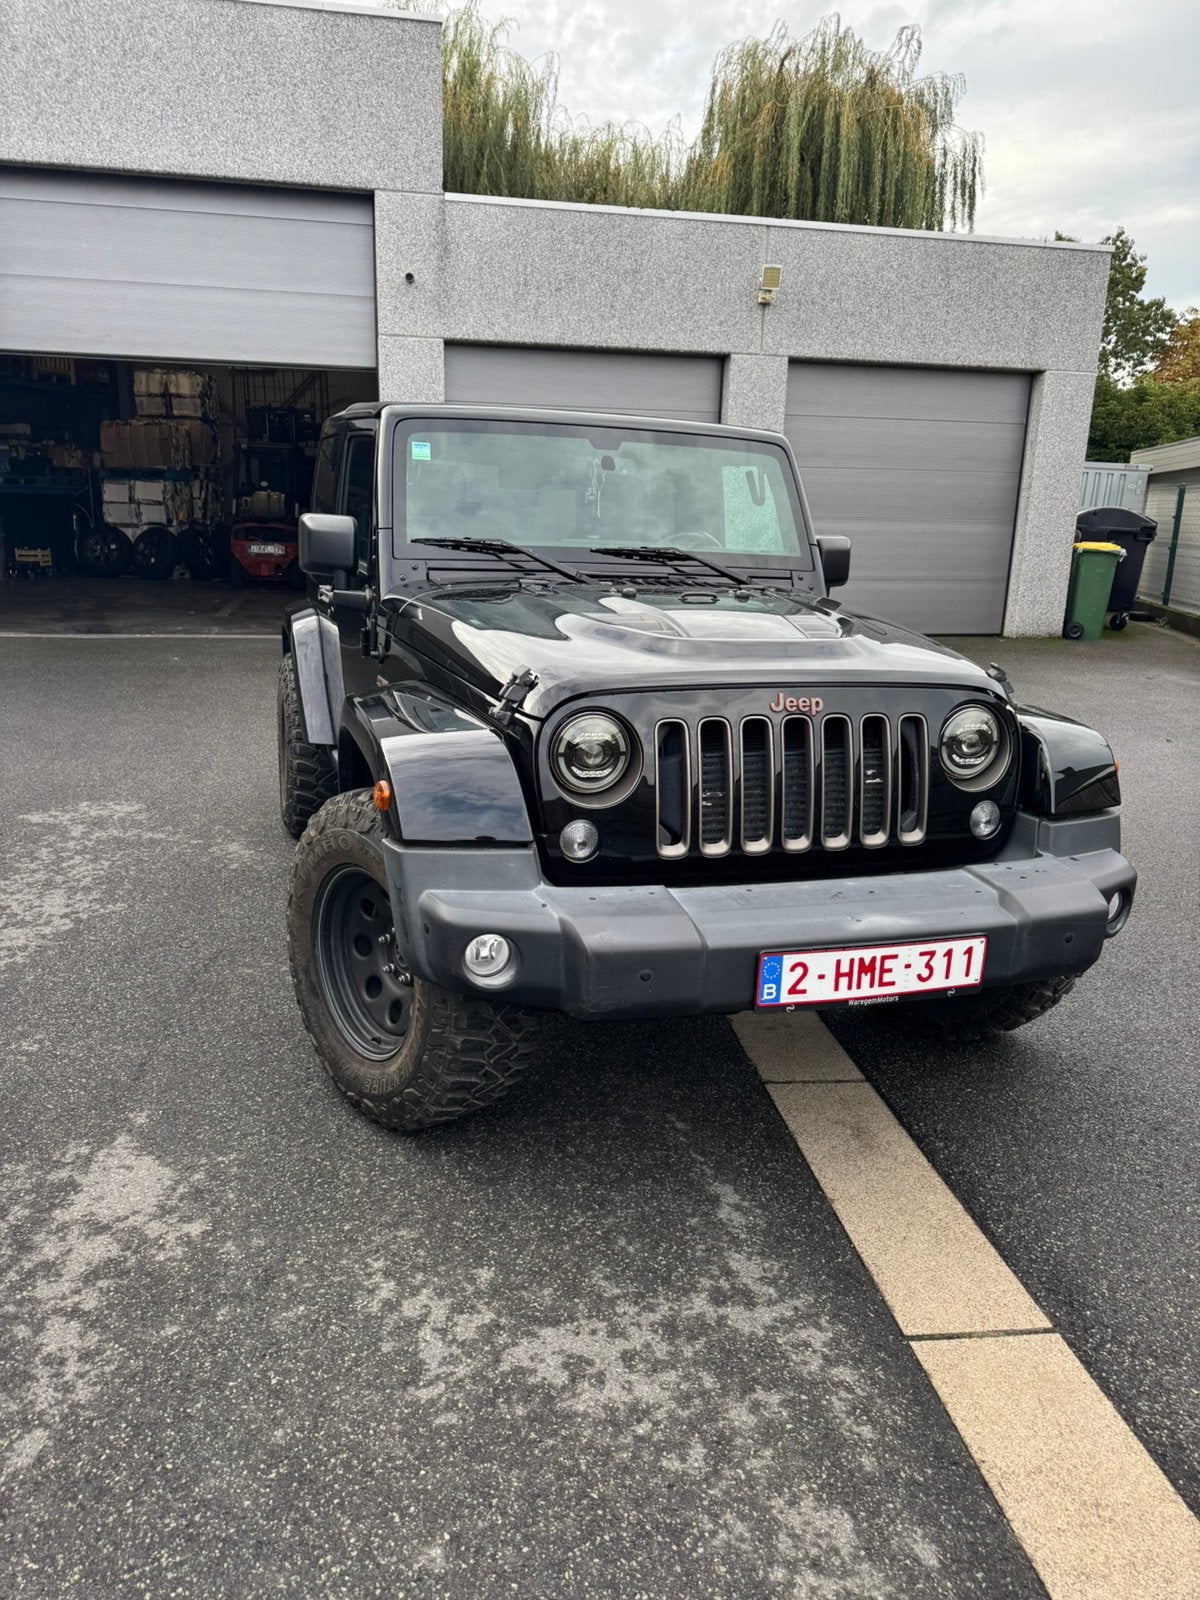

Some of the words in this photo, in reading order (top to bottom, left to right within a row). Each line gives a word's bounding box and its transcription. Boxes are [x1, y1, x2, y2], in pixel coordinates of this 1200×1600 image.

[769, 692, 823, 716] Jeep
[787, 946, 974, 995] 2-HME-311
[763, 983, 777, 1000] B
